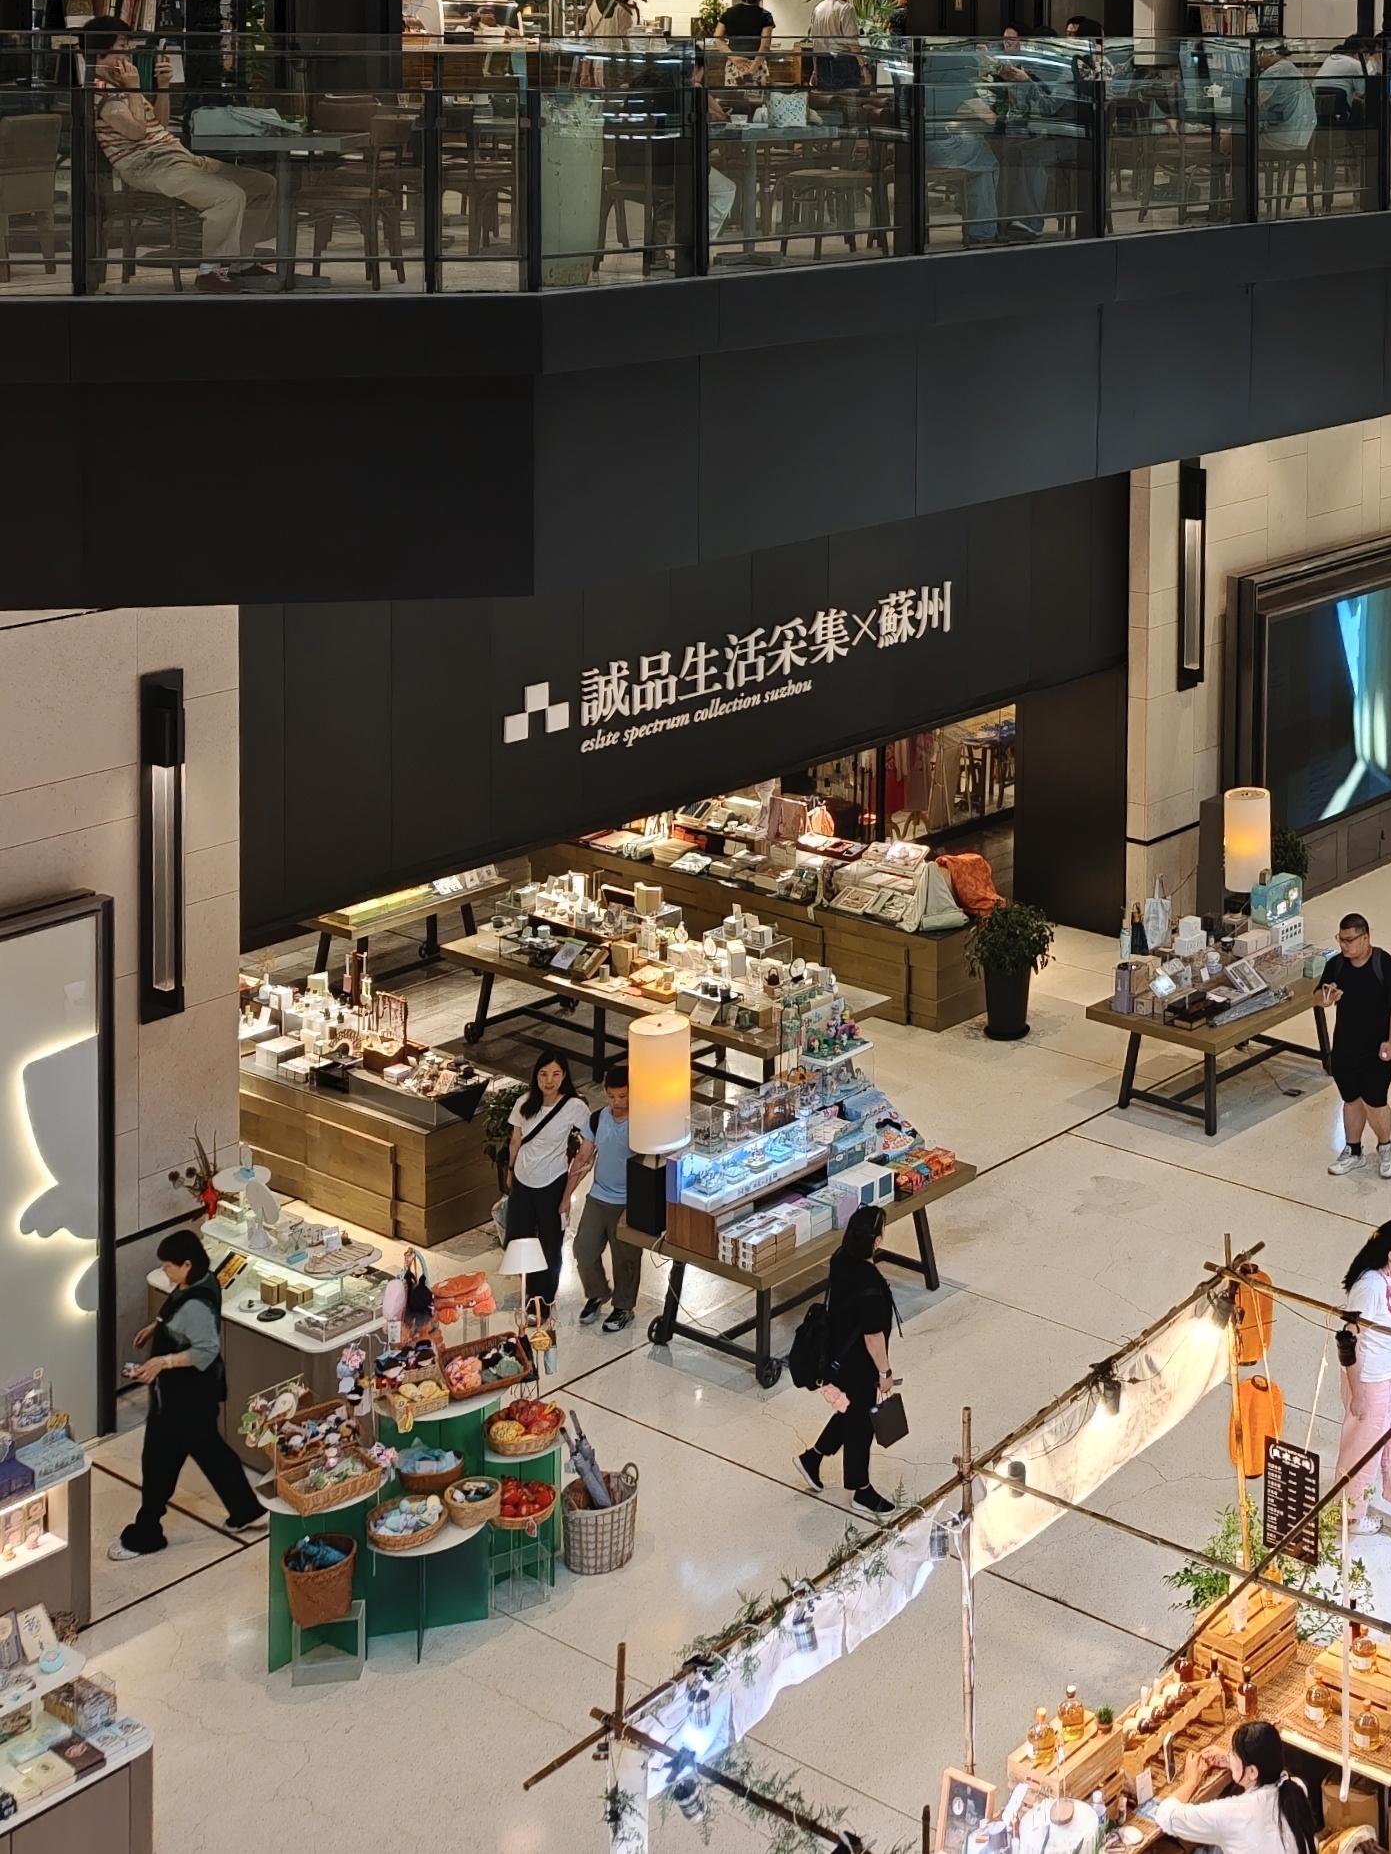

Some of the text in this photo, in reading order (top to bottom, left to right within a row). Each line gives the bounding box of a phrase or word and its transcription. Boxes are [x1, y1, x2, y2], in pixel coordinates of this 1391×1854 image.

[580, 677, 812, 754] eslite spectrum collection suzhou
